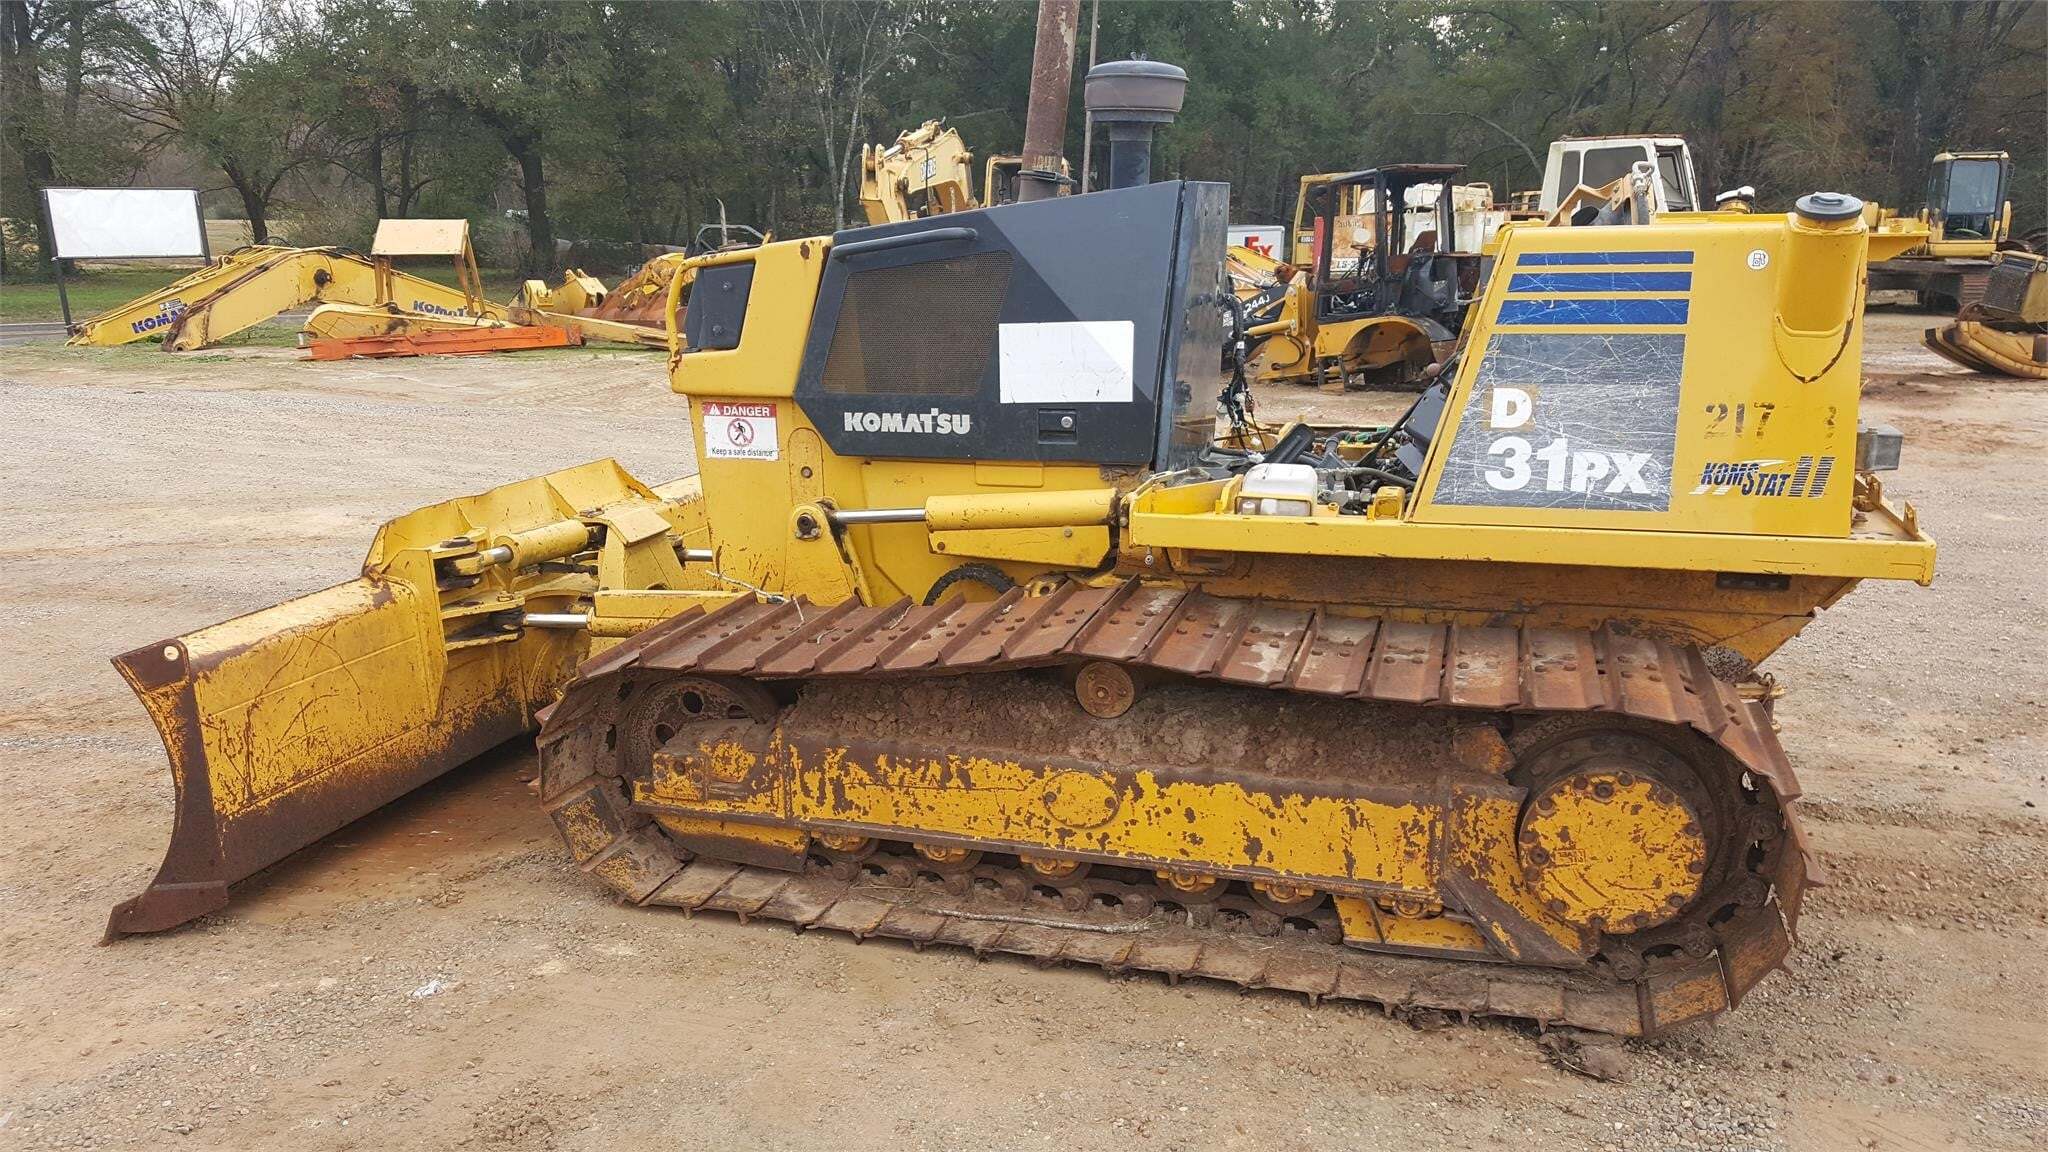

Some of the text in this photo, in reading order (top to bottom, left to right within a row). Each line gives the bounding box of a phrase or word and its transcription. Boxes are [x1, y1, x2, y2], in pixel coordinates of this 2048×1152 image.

[1245, 295, 1270, 313] 244J
[723, 405, 770, 417] DANGER
[1491, 388, 1533, 429] D
[844, 407, 971, 435] KOMATSU
[711, 446, 727, 457] Keep
[734, 447, 746, 457] safe
[747, 448, 773, 458] distance
[1485, 436, 1652, 494] 31PX
